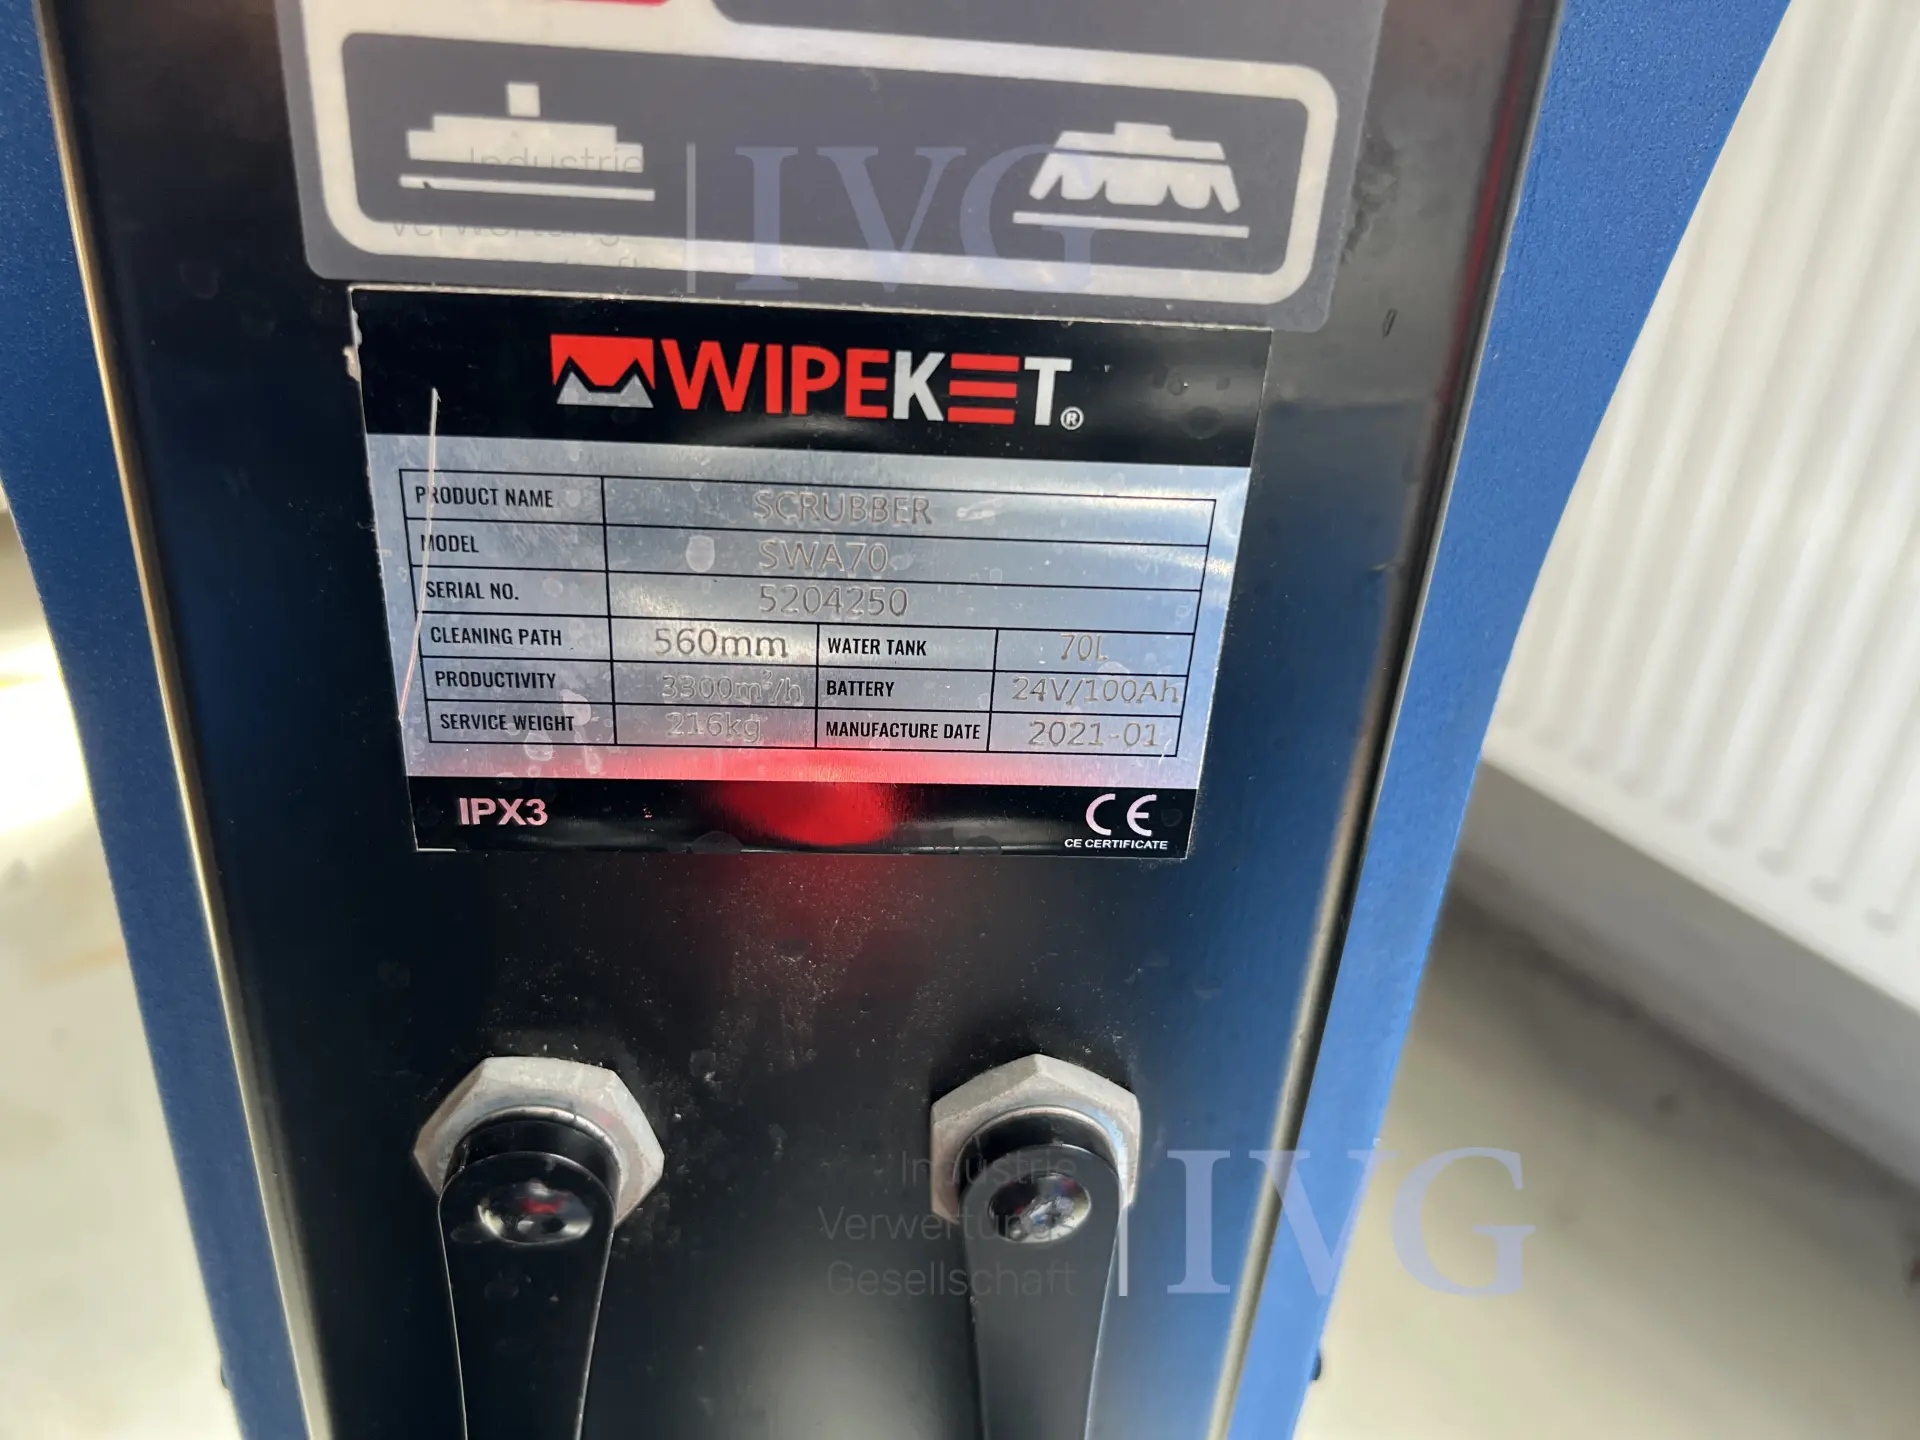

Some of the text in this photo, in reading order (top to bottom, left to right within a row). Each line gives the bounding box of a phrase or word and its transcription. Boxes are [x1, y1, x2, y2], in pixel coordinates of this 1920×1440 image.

[415, 486, 554, 508] PRODUCT NAME
[753, 489, 932, 525] SCRUBBER
[421, 534, 479, 553] MODEL
[759, 539, 888, 573] SWA70
[426, 581, 519, 601] SERIAL NO.
[759, 584, 908, 617] 5204250
[430, 627, 562, 647] CLEANING PATH
[655, 627, 788, 659] 560mm
[827, 636, 927, 656] WATER TANK
[1060, 632, 1108, 661] 70L
[434, 670, 556, 690] PRODUCTIVITY
[826, 679, 894, 698] BATTERY
[1012, 677, 1179, 705] 24V/100Ah
[440, 713, 575, 733] SERVICE WEIGHT
[666, 711, 761, 743] 216kg
[825, 721, 981, 741] MANUFACTURE DATE
[1027, 721, 1160, 747] 2021-01
[459, 797, 548, 826] IPX3
[1086, 793, 1157, 837] CE
[1064, 838, 1168, 850] CE CERTIFICATE
